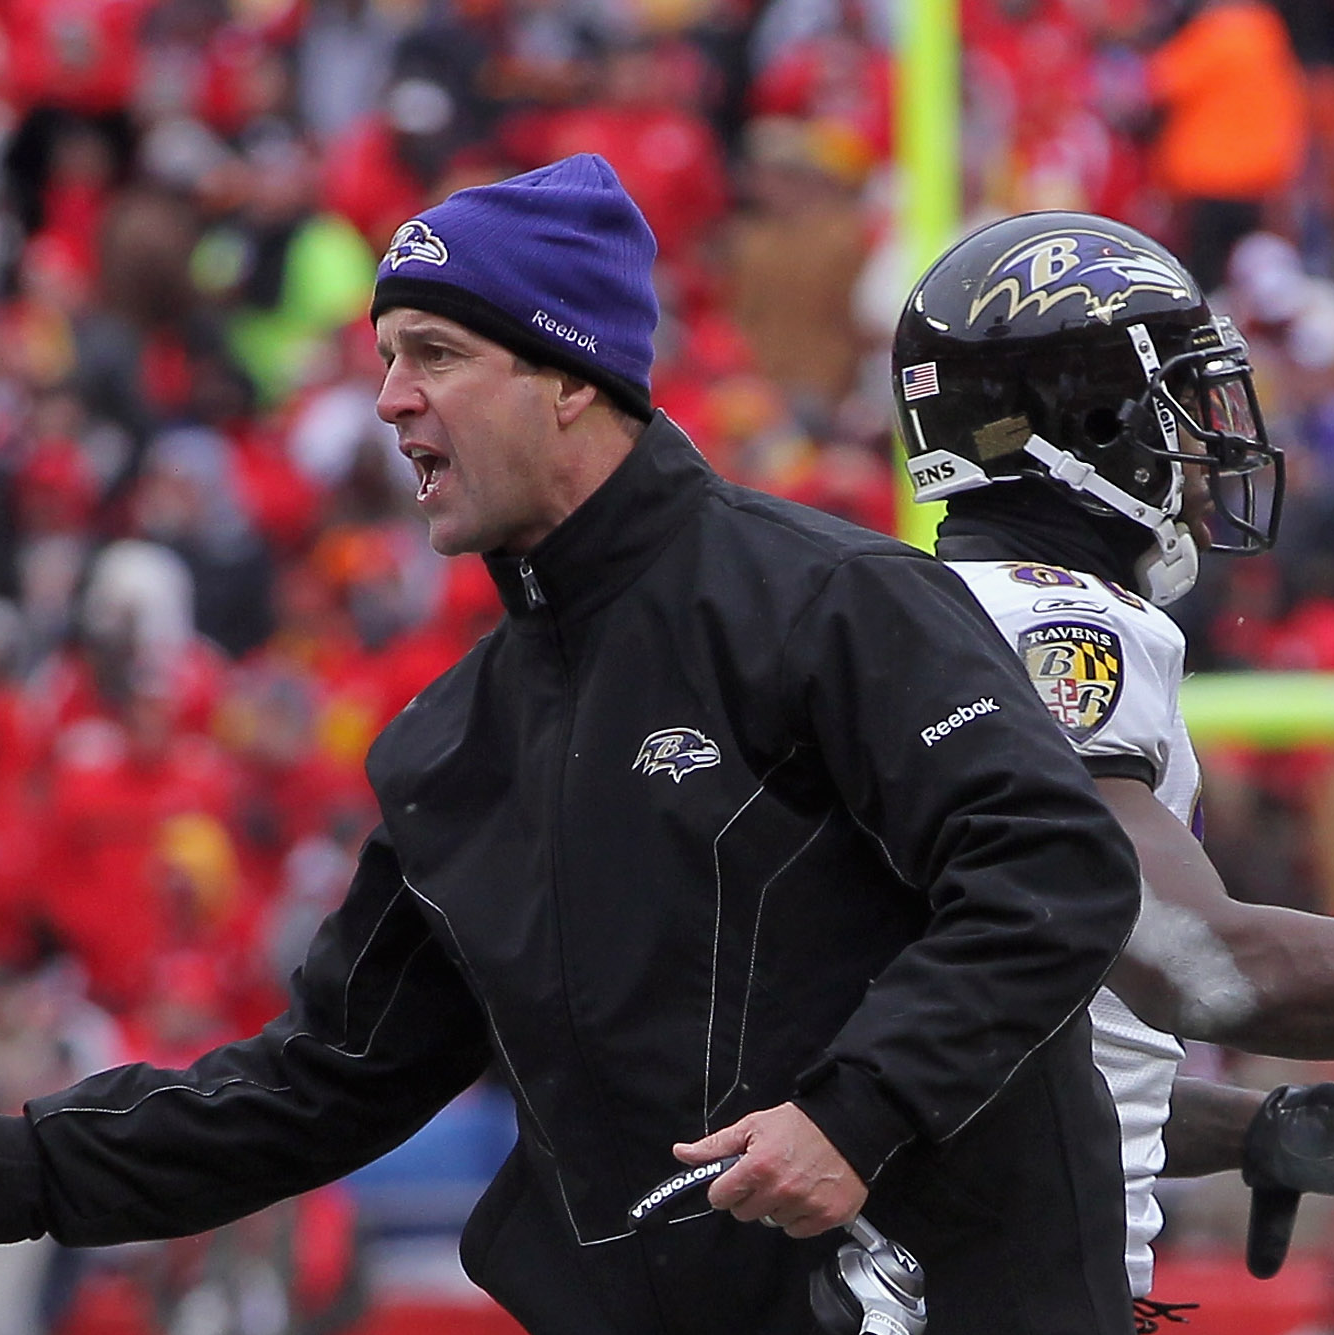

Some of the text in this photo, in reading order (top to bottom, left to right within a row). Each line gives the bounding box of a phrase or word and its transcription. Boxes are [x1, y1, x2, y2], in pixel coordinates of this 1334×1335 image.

[1002, 237, 1082, 292] B
[532, 308, 600, 354] Reebok
[1026, 625, 1113, 647] RAVENS
[920, 696, 1000, 748] Reebok
[631, 1161, 723, 1220] MOTOROLA
